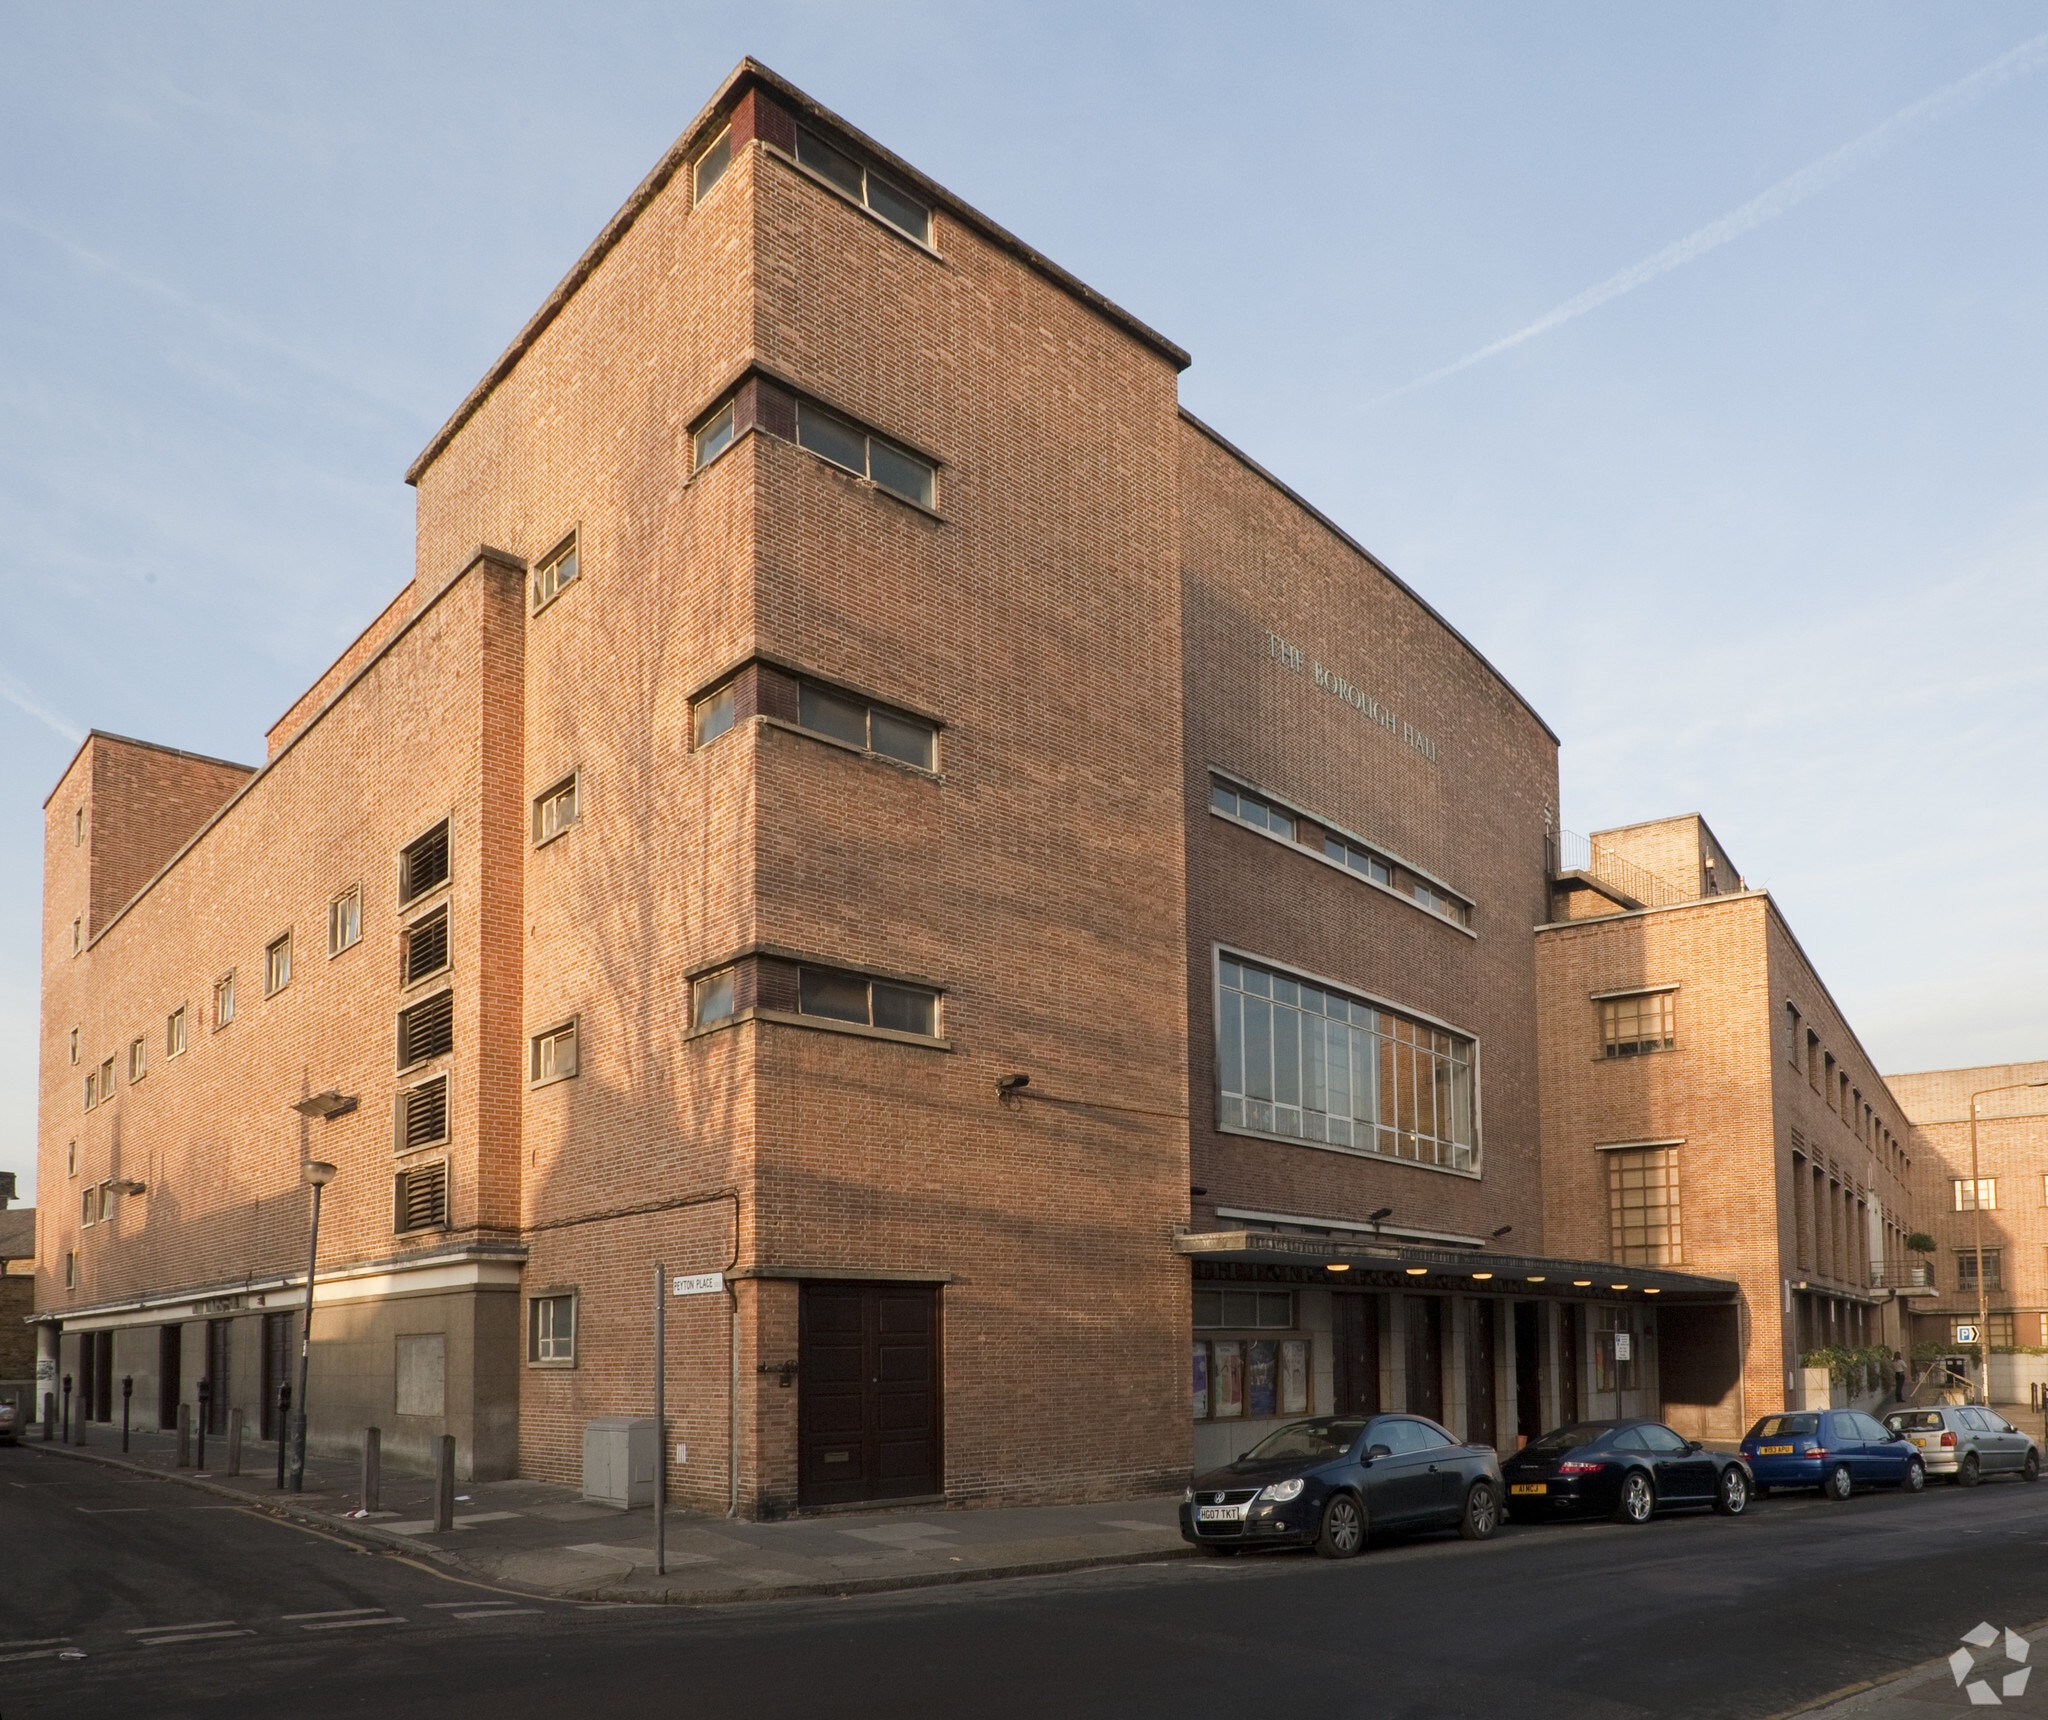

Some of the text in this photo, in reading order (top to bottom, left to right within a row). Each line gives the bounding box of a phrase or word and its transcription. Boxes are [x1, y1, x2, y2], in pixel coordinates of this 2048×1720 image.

[1266, 629, 1437, 764] THE BOROUGH HALL
[674, 1280, 694, 1291] PEYTON
[696, 1278, 713, 1289] PLACE
[1961, 1329, 1969, 1341] P
[1221, 1509, 1237, 1519] TKT
